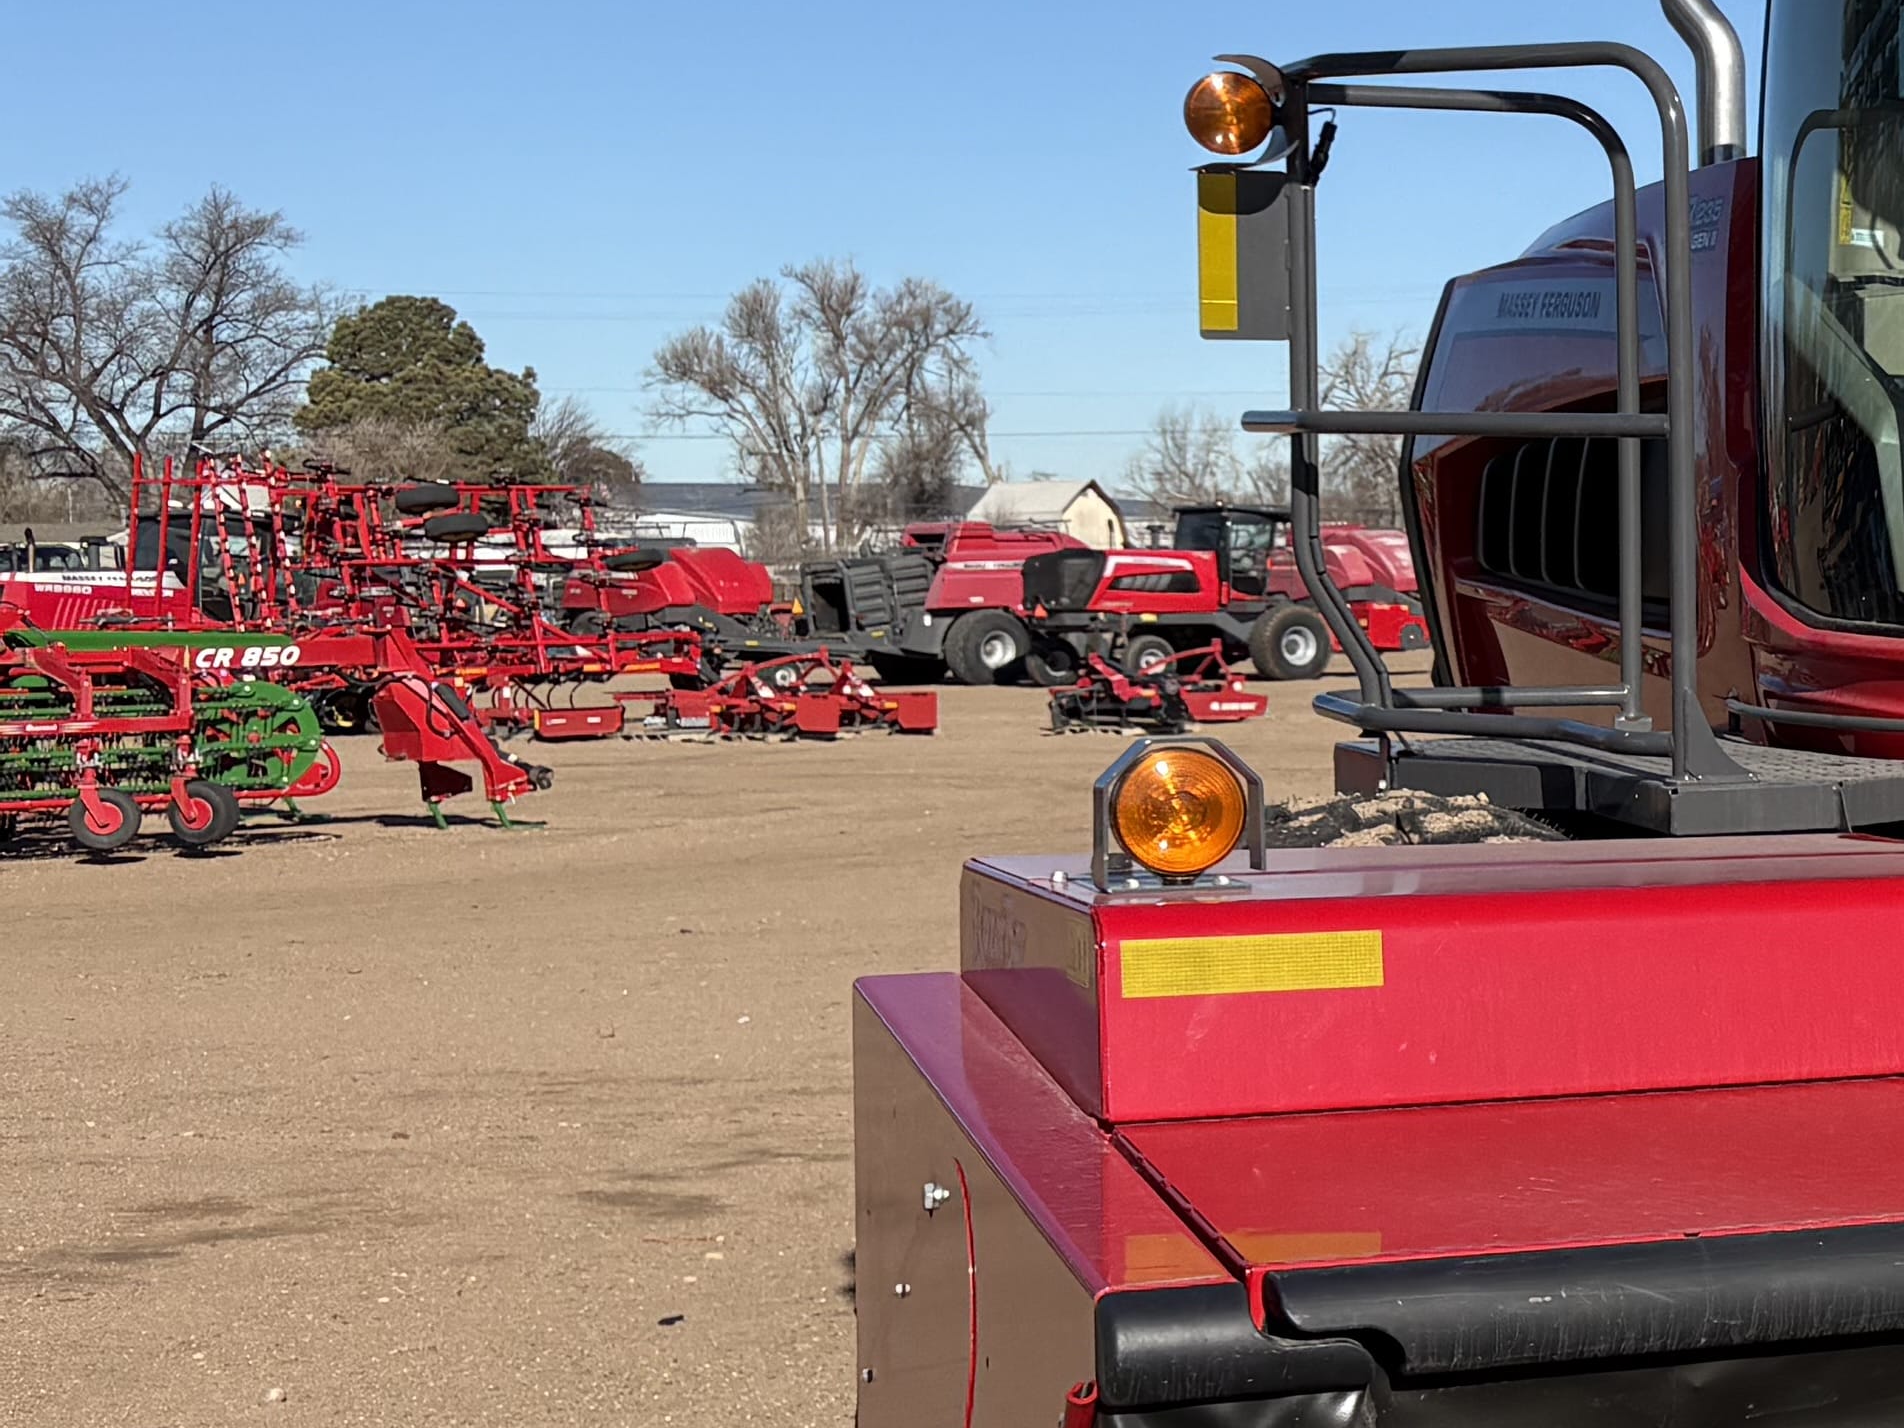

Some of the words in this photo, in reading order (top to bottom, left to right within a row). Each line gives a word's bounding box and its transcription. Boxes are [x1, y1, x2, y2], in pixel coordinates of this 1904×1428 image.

[1496, 291, 1540, 318] MASSEY
[1540, 291, 1602, 318] FERGUSON
[195, 647, 234, 668] CR
[240, 645, 301, 668] 850
